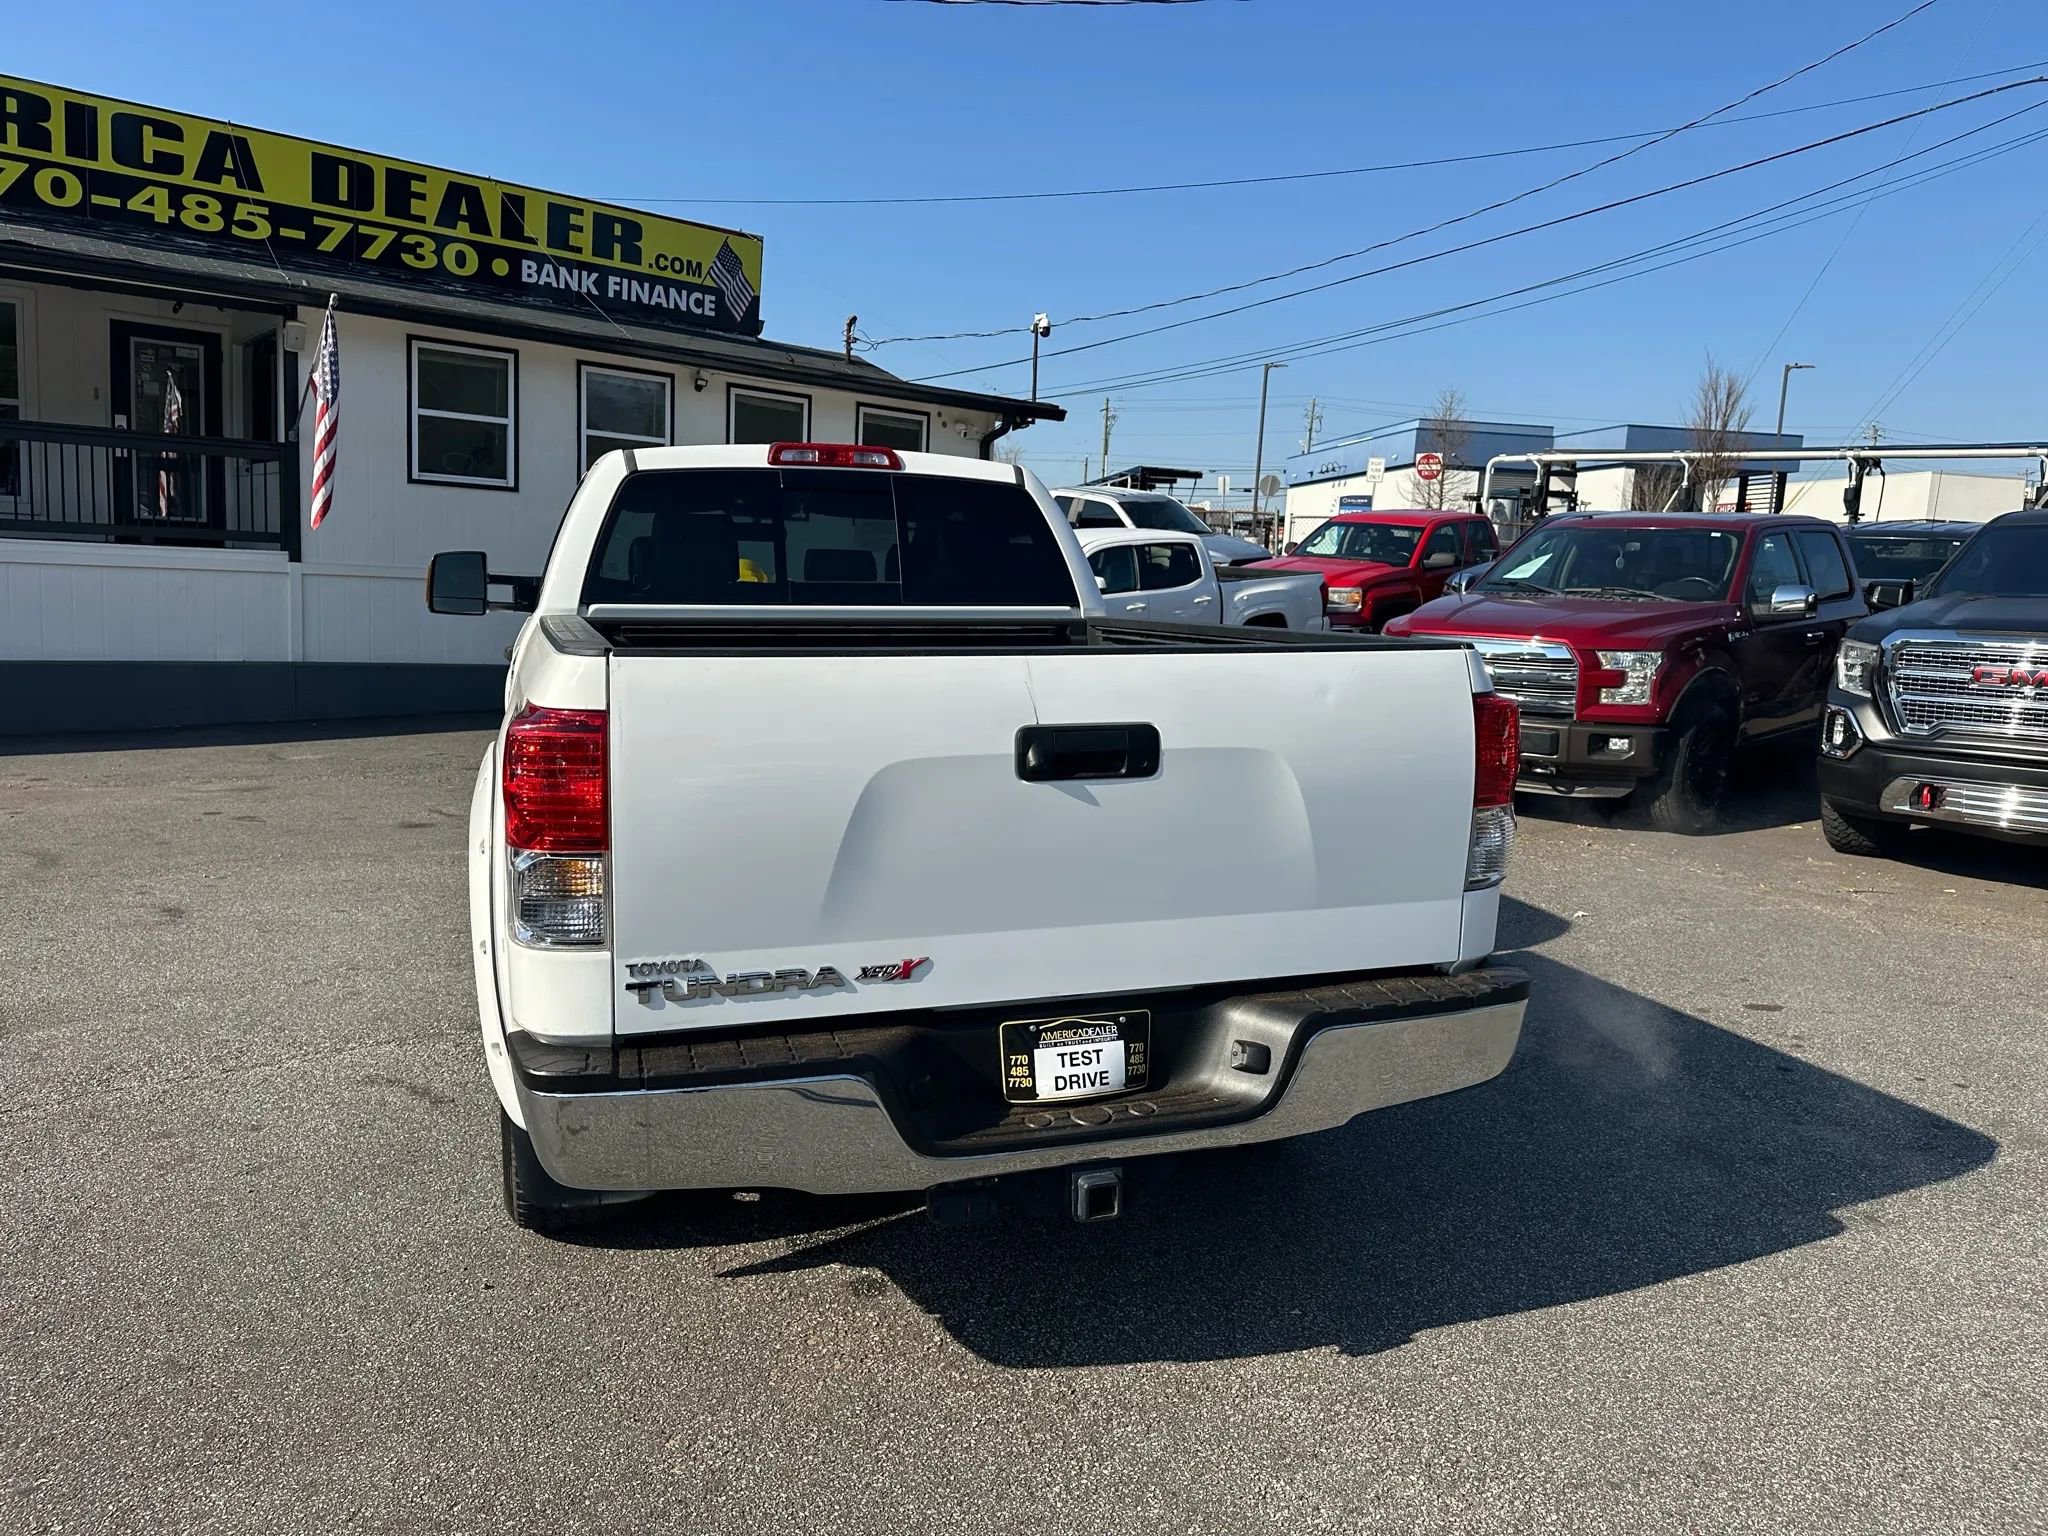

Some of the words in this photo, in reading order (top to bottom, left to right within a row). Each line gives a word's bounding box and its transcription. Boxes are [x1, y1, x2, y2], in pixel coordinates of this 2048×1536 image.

[0, 86, 265, 193] RICA
[521, 259, 599, 296] BANK
[608, 275, 716, 317] FINANCE
[625, 958, 705, 977] TOYOTA
[625, 966, 846, 1004] TUNDRA
[1129, 1042, 1144, 1053] 770
[1009, 1055, 1028, 1065] 770
[1057, 1049, 1104, 1068] TEST
[1130, 1053, 1144, 1064] 485
[1010, 1066, 1029, 1076] 485
[1127, 1064, 1146, 1075] 7730
[1008, 1077, 1033, 1087] 7730
[1055, 1071, 1109, 1091] DRIVE
